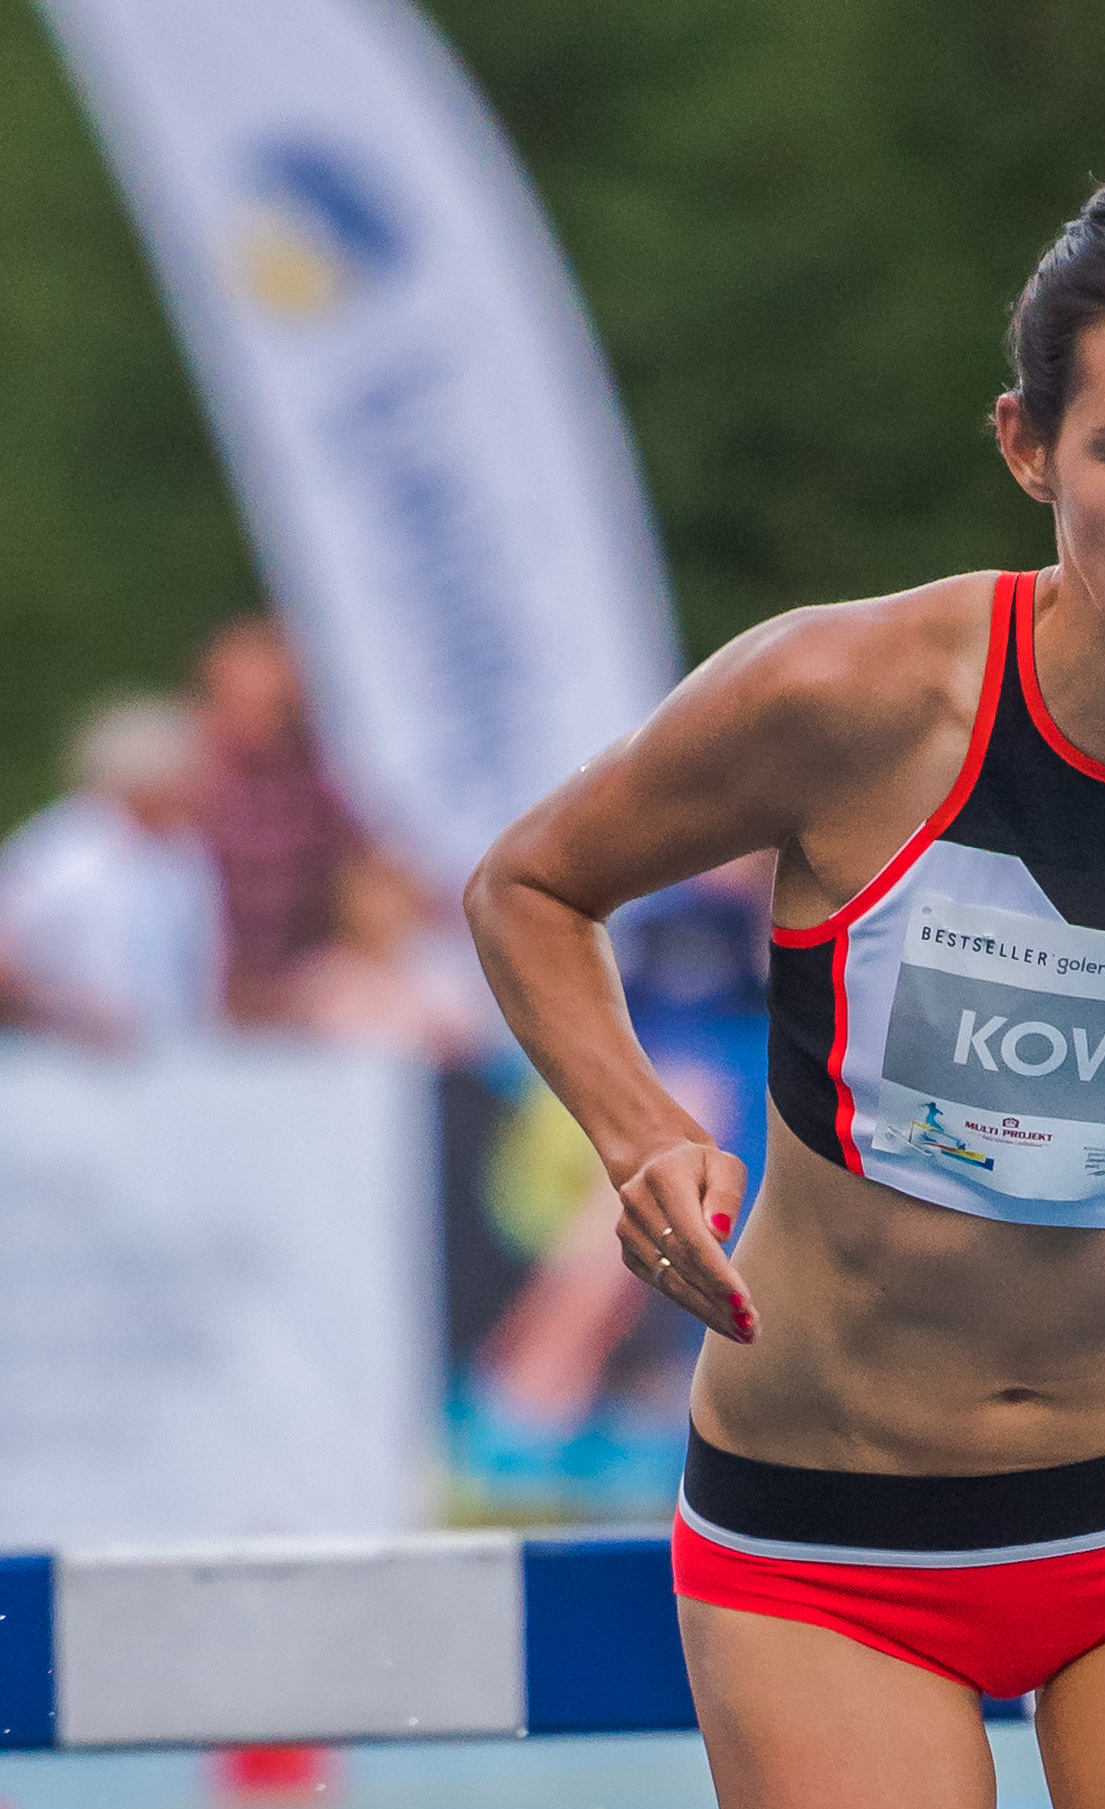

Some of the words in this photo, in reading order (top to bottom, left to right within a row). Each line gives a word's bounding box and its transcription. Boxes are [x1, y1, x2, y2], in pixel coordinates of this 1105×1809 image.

[921, 926, 1048, 966] BESTSELLER
[965, 1120, 999, 1136] MULTI
[1002, 1129, 1053, 1142] PROJEKT
